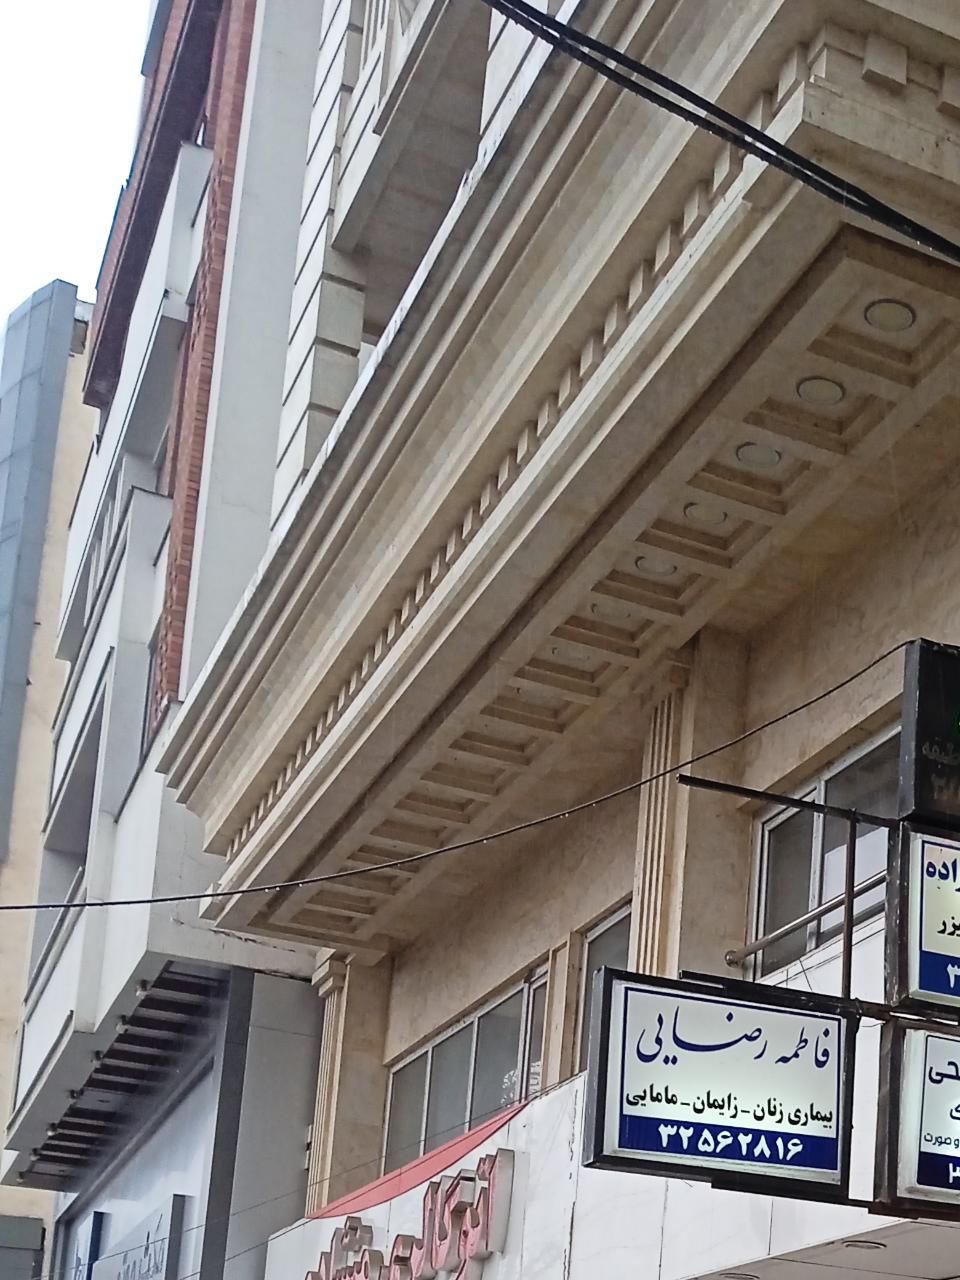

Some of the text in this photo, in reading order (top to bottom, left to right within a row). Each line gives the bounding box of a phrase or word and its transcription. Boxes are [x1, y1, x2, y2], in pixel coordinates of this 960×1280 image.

[775, 1027, 831, 1068] فاطمه
[625, 1083, 678, 1106] مامایی
[693, 1090, 738, 1118] زایمان
[753, 1098, 784, 1123] زنان
[787, 1103, 833, 1129] بیماری
